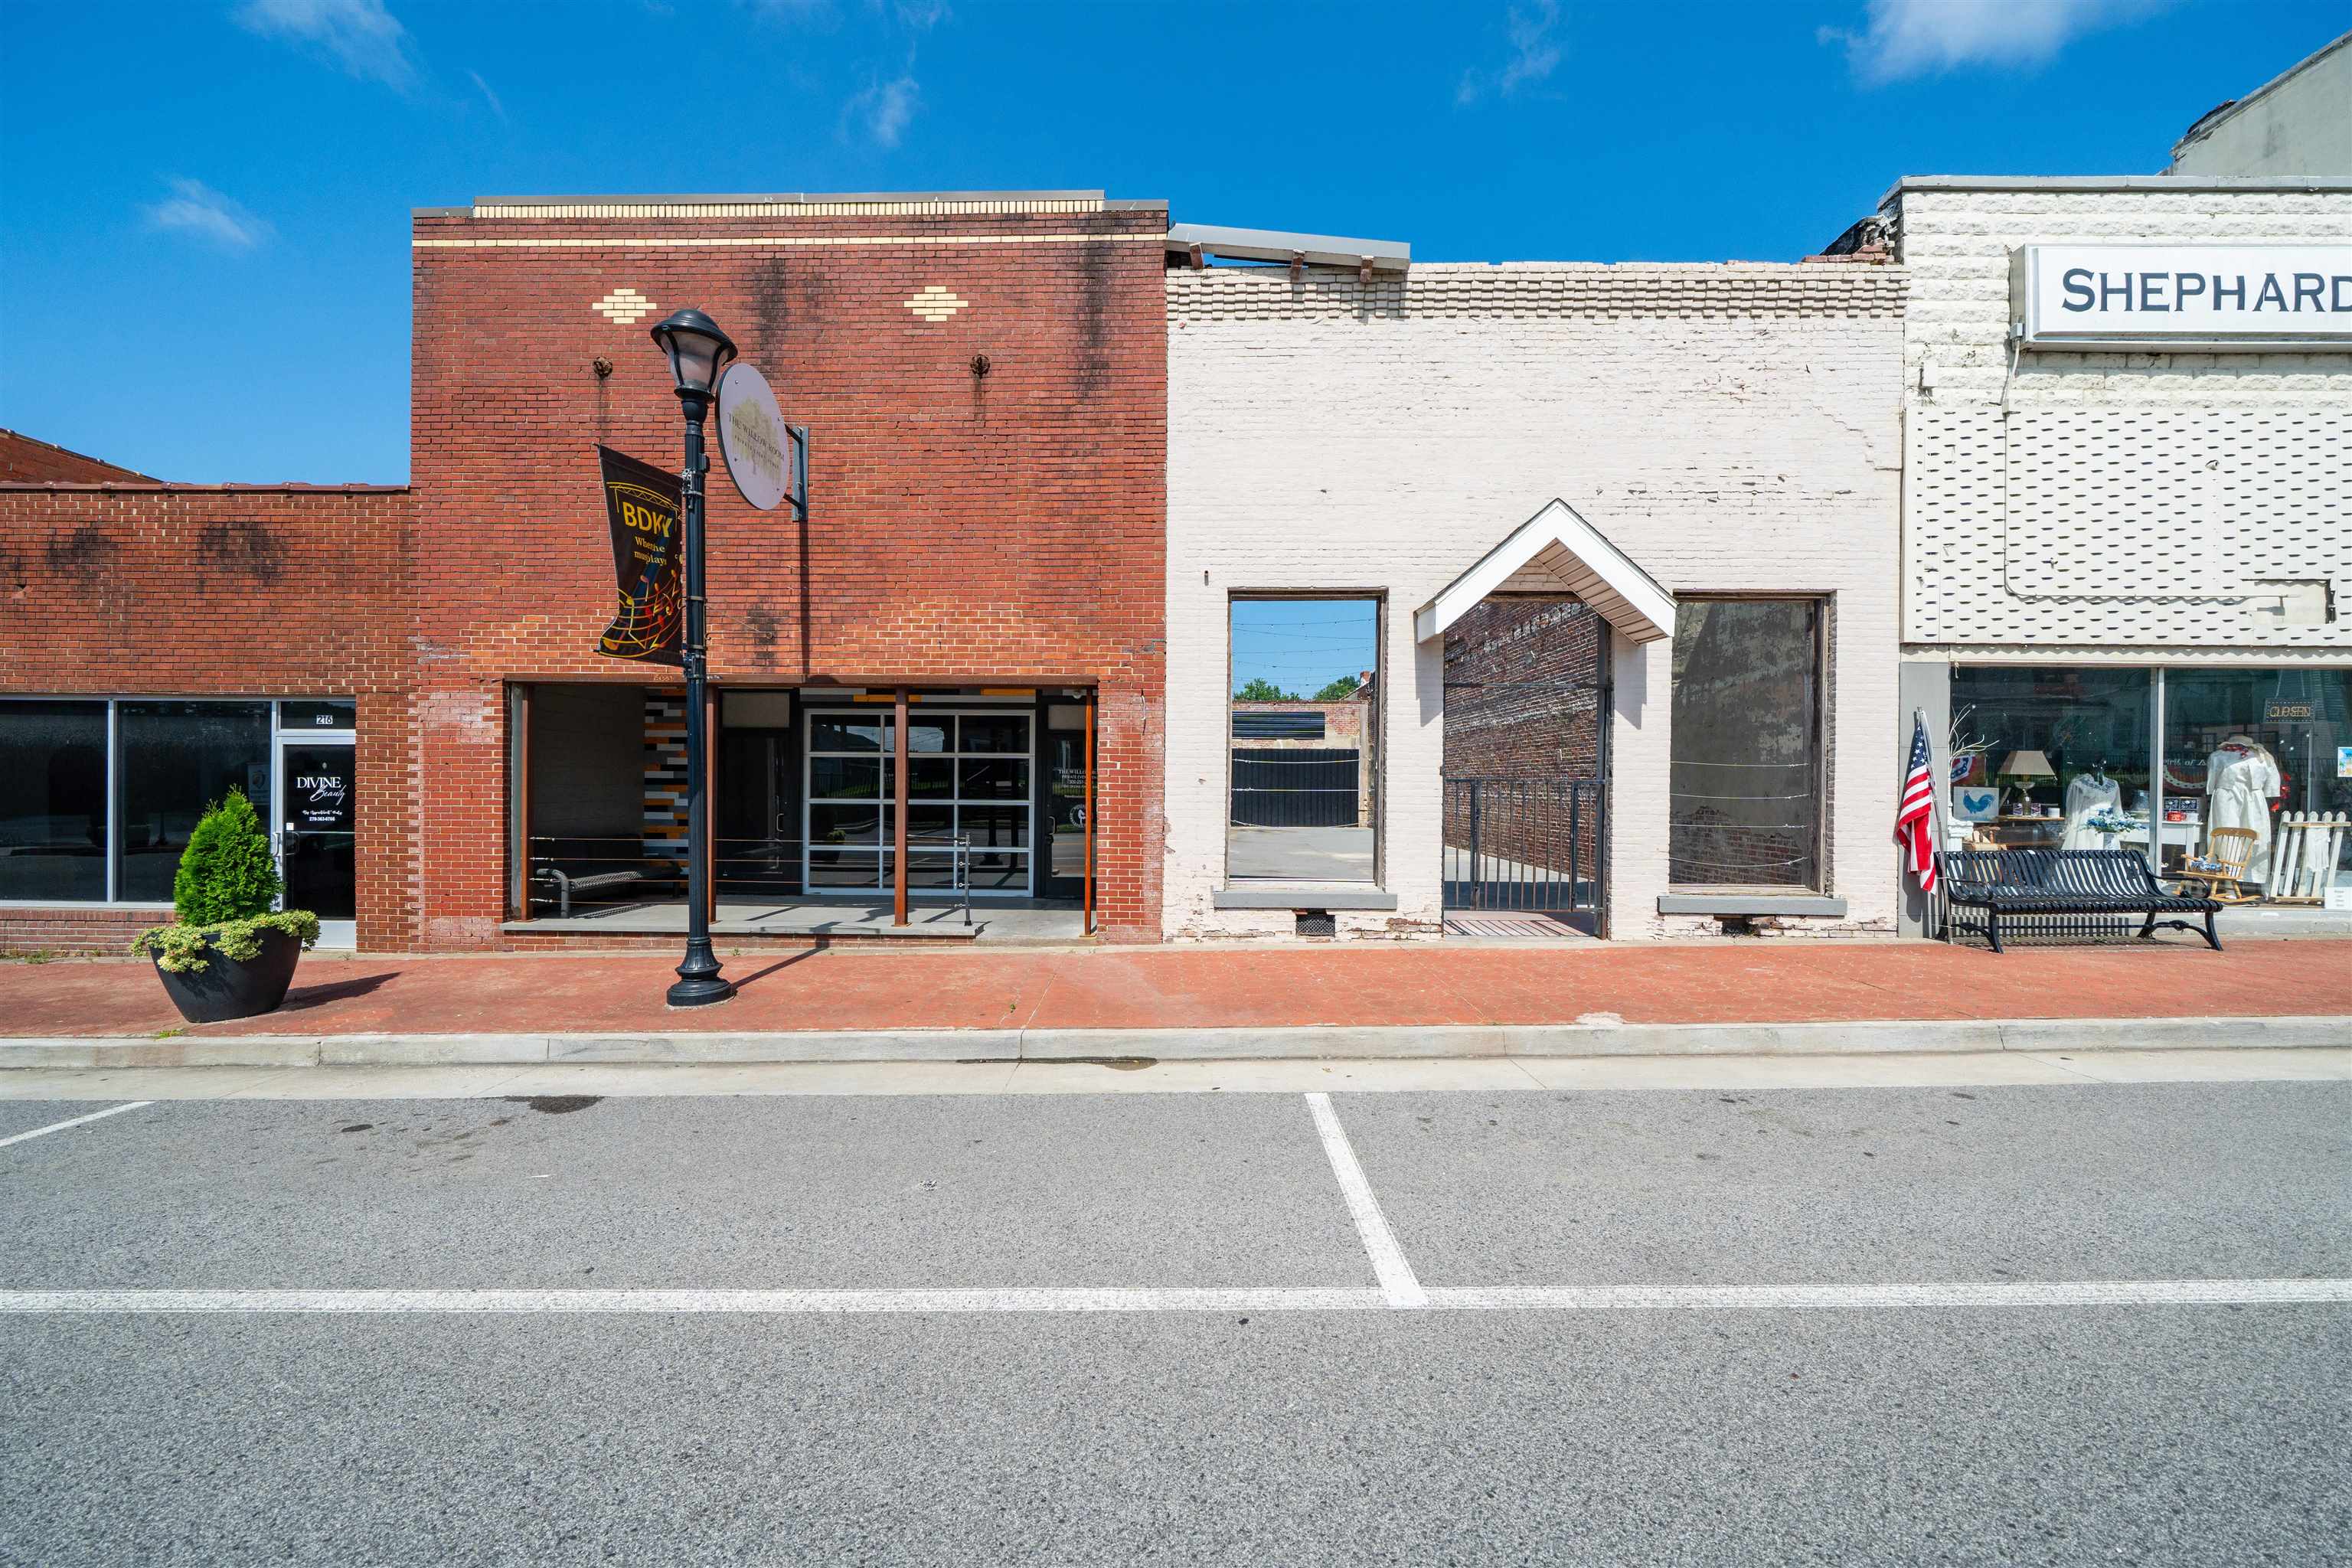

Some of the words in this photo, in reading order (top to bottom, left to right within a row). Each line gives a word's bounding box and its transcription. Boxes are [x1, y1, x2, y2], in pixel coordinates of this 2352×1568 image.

[622, 501, 673, 538] BDKY
[317, 715, 332, 724] 216
[297, 776, 341, 789] DIVINE
[309, 784, 347, 805] Beauty
